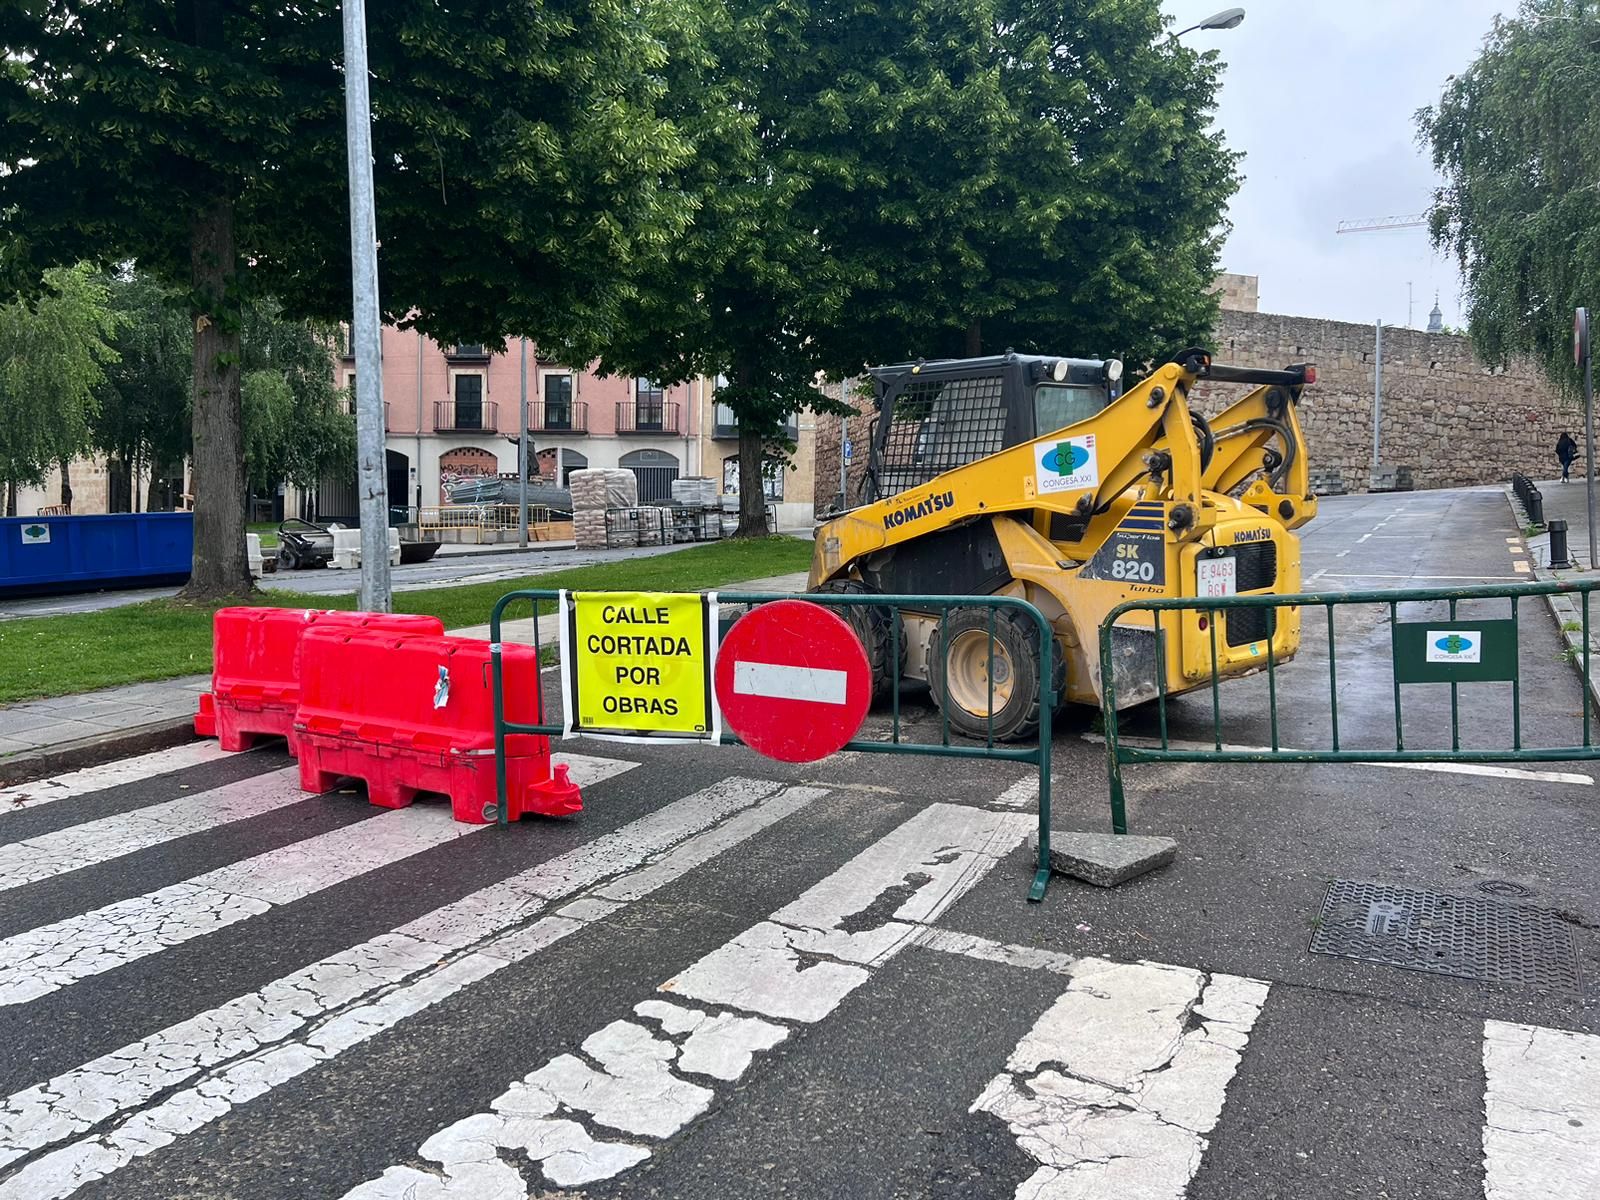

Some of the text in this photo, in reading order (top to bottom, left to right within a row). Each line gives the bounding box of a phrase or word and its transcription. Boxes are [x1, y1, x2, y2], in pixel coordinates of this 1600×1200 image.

[1054, 451, 1076, 467] CG
[1043, 476, 1079, 488] CONGESA
[1080, 474, 1092, 483] XXI
[883, 490, 954, 530] KOMATSU
[1234, 526, 1271, 543] KOMATSU
[1116, 543, 1139, 559] SK
[1111, 559, 1155, 581] 820
[1201, 562, 1233, 580] E 9463
[1129, 583, 1164, 594] Turbo
[602, 605, 670, 625] CALLE
[587, 634, 692, 656] CORTADA
[616, 666, 660, 685] POR
[603, 695, 679, 716] OBRAS
